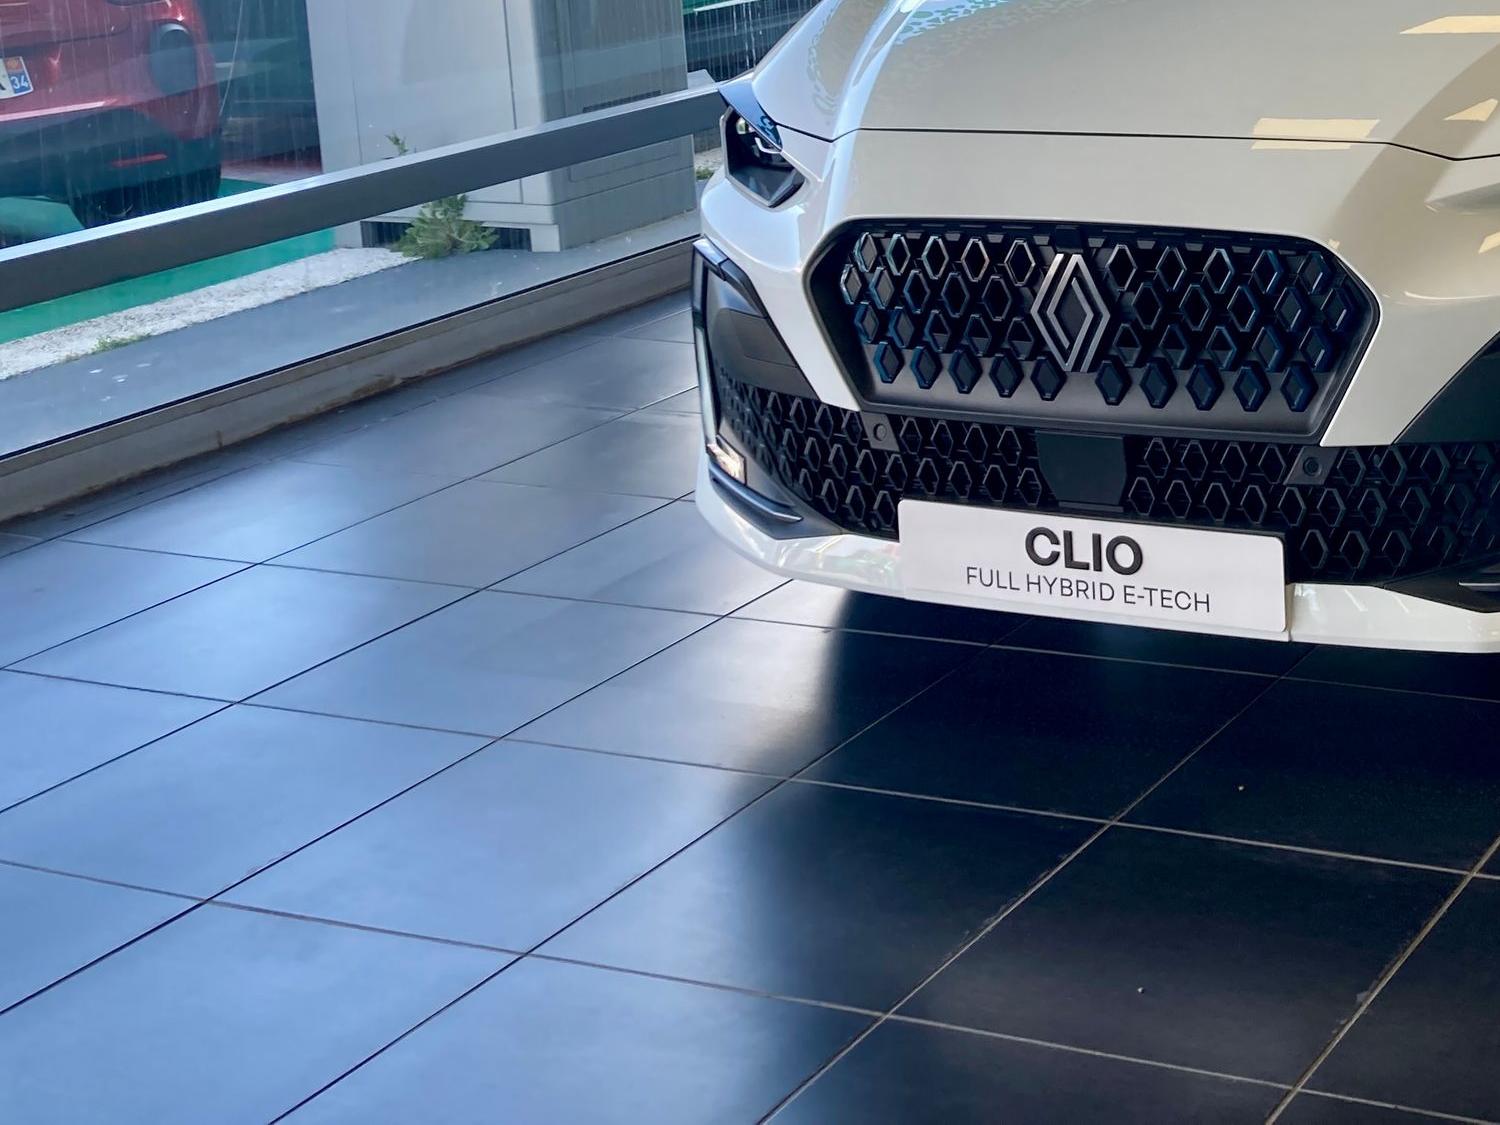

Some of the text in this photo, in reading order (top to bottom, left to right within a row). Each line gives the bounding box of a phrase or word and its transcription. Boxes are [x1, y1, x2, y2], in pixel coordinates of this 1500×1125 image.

[10, 74, 29, 90] 34
[1025, 526, 1144, 575] CLIO
[966, 567, 1211, 613] FULL HYBRID E-TECH
